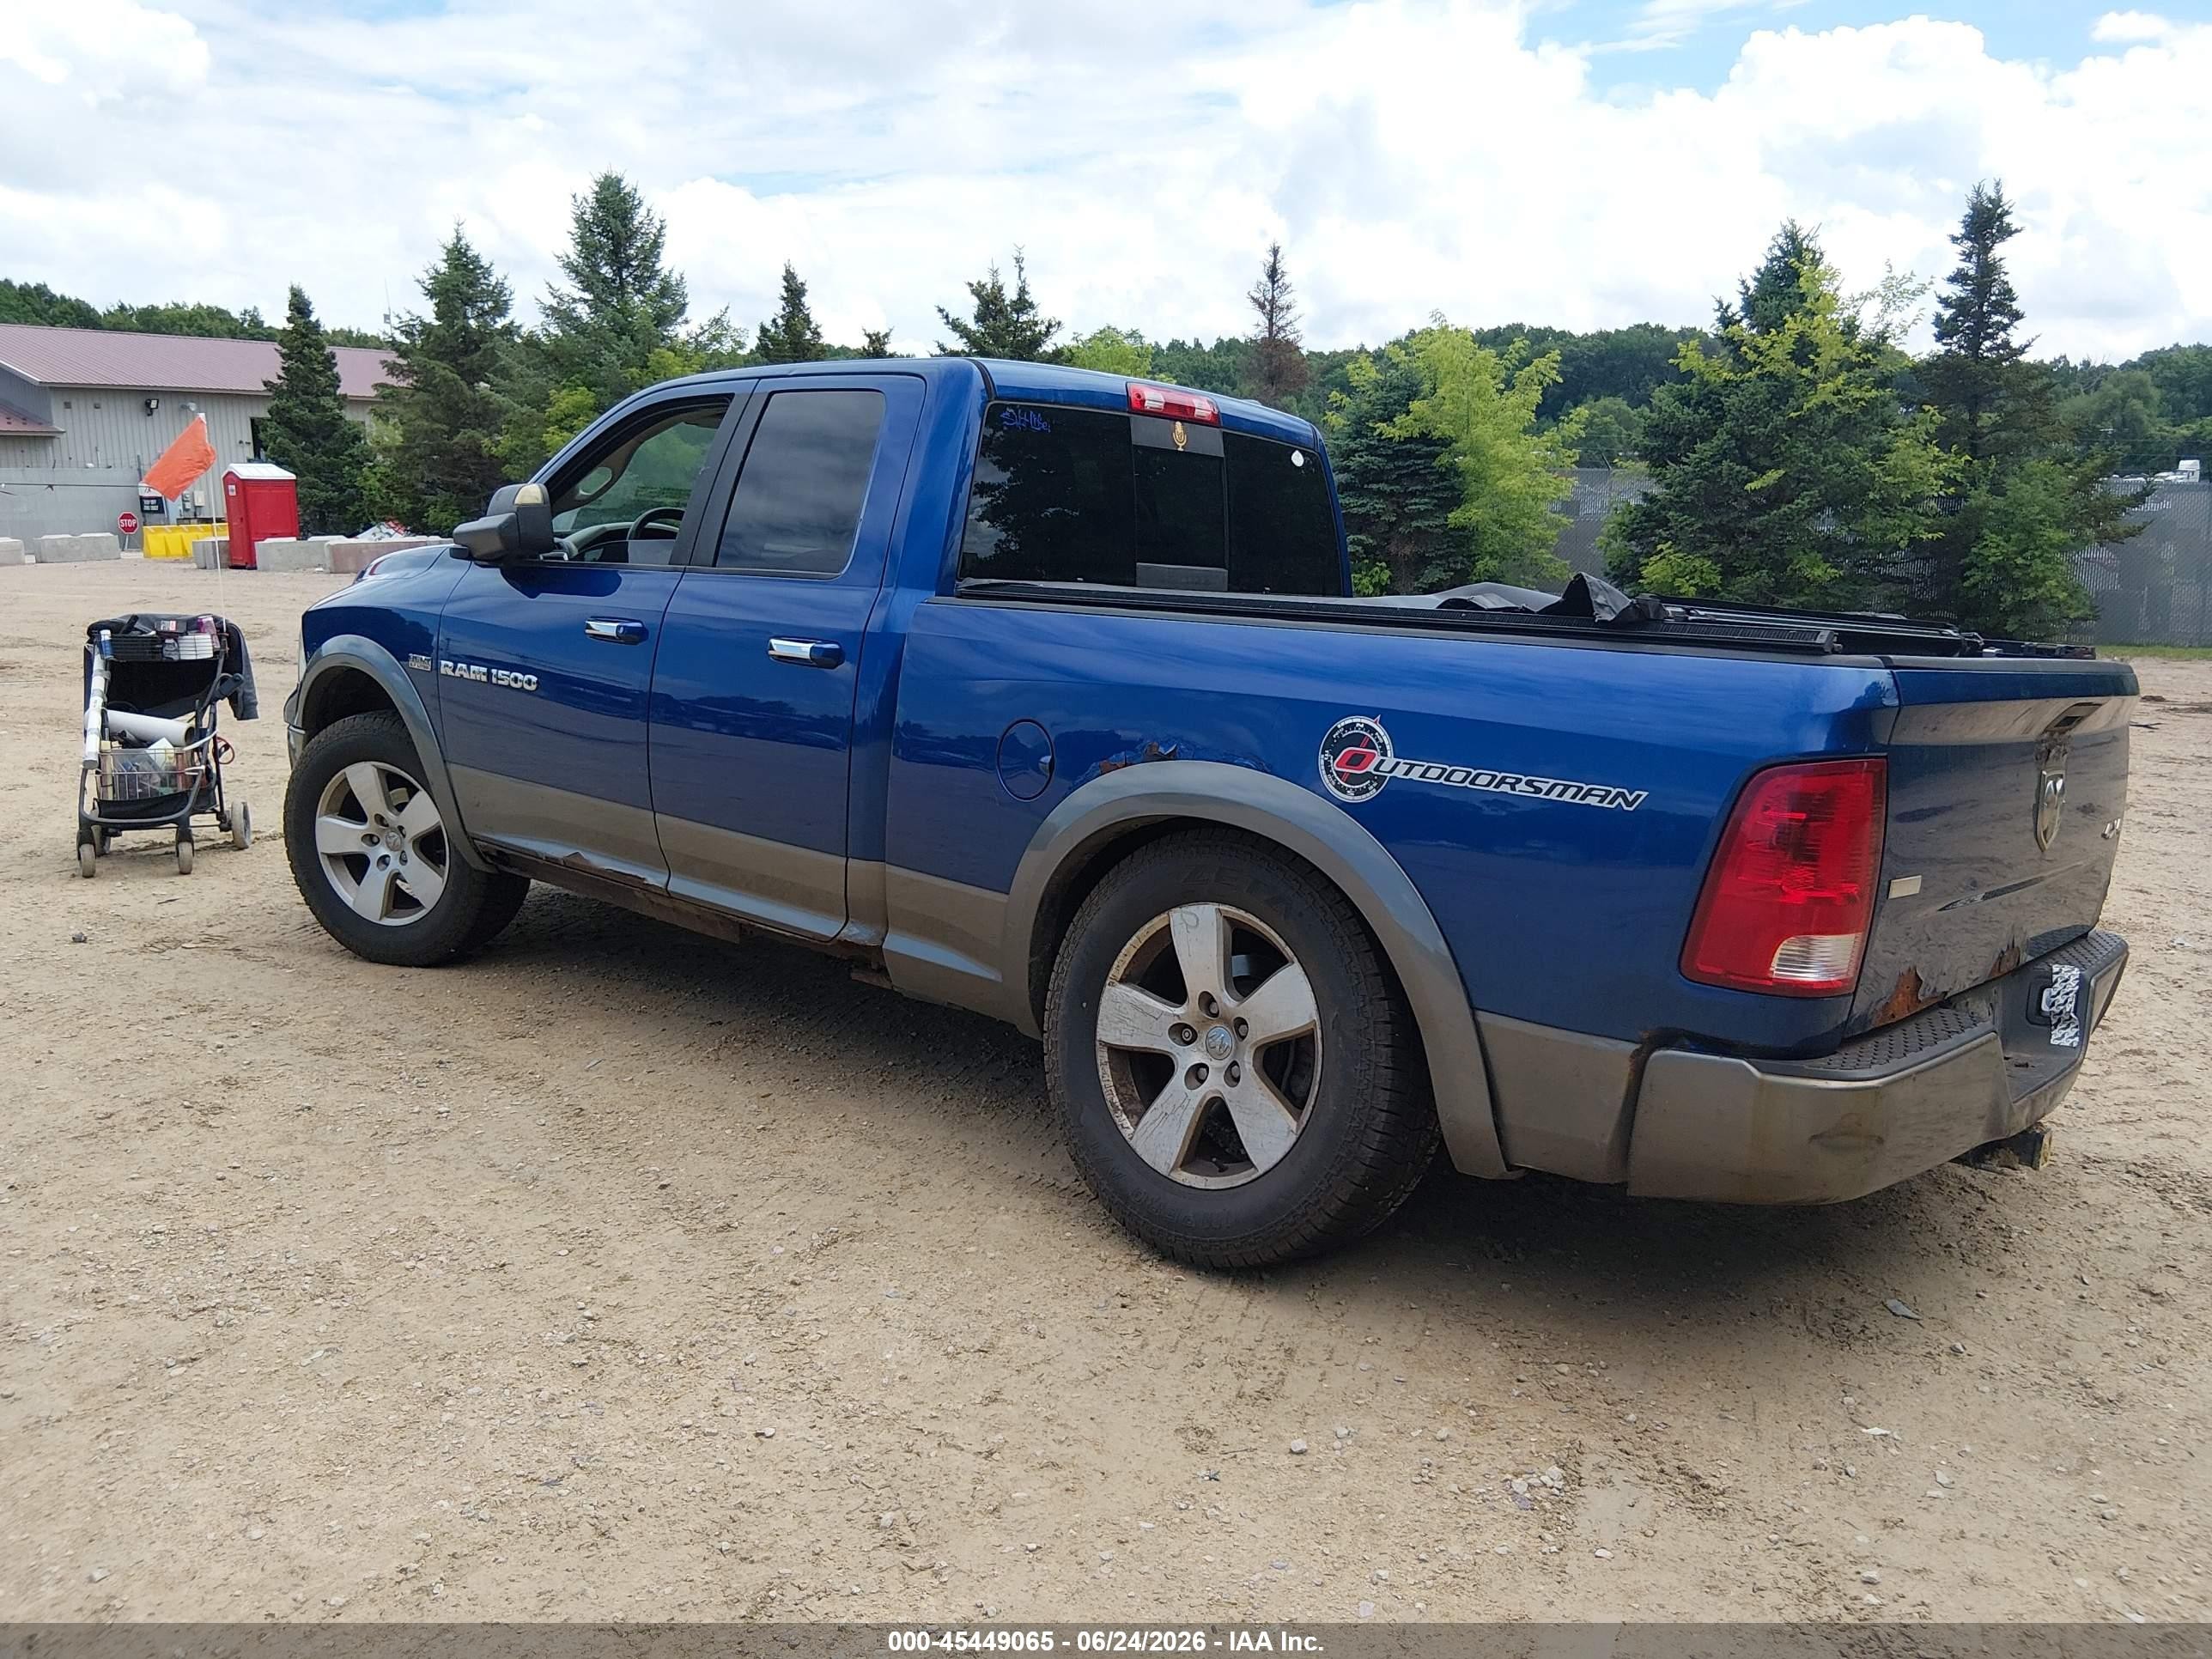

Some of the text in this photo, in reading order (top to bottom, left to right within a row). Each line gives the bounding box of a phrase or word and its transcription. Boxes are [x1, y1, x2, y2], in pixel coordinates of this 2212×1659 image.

[120, 519, 136, 527] STOP
[440, 659, 538, 691] RAM 1500
[1334, 748, 1647, 810] OUTDOORSMAN
